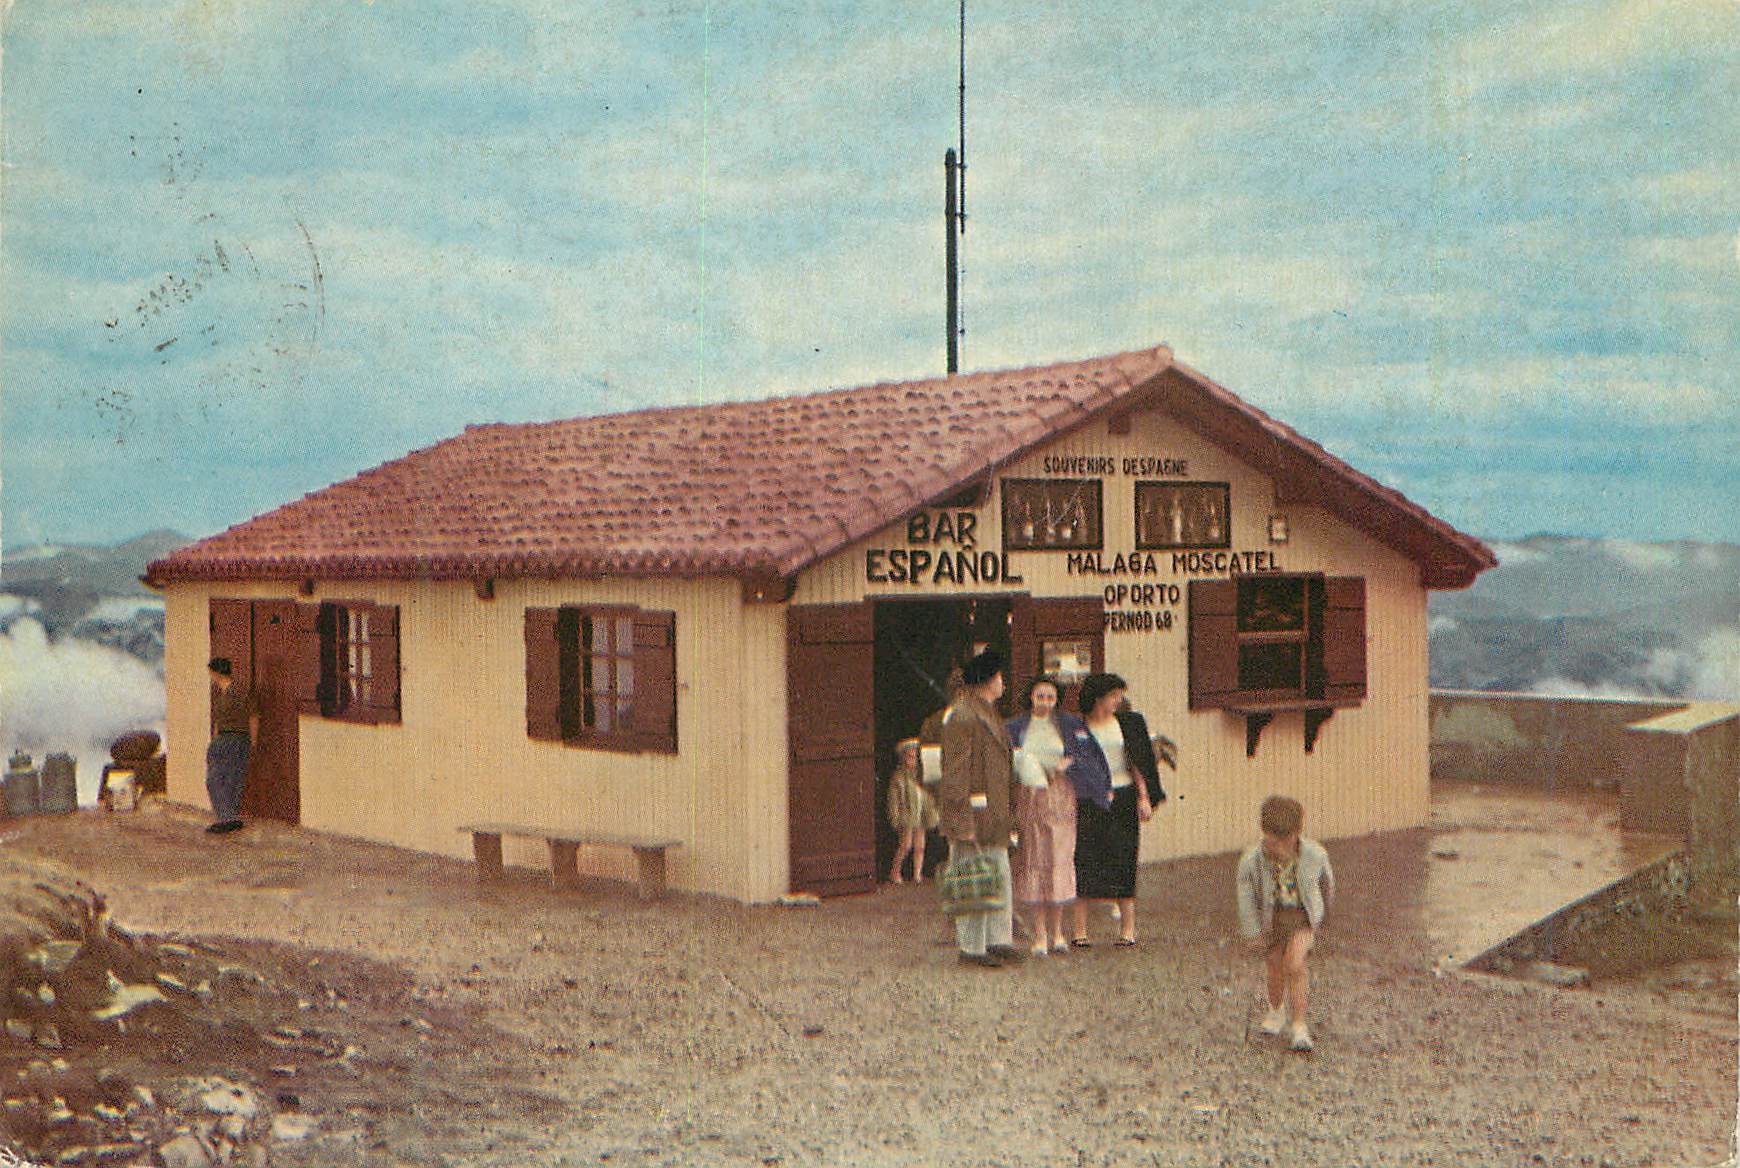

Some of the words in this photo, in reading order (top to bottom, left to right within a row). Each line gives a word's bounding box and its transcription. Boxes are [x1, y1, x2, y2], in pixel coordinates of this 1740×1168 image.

[1044, 457, 1115, 475] SOUVENIRS
[907, 511, 977, 544] BAR
[866, 544, 1023, 584] ESPAÑOL
[1067, 553, 1158, 575] MALAGA
[1172, 552, 1281, 575] MOSCATEL
[1104, 584, 1180, 604] OPORTO
